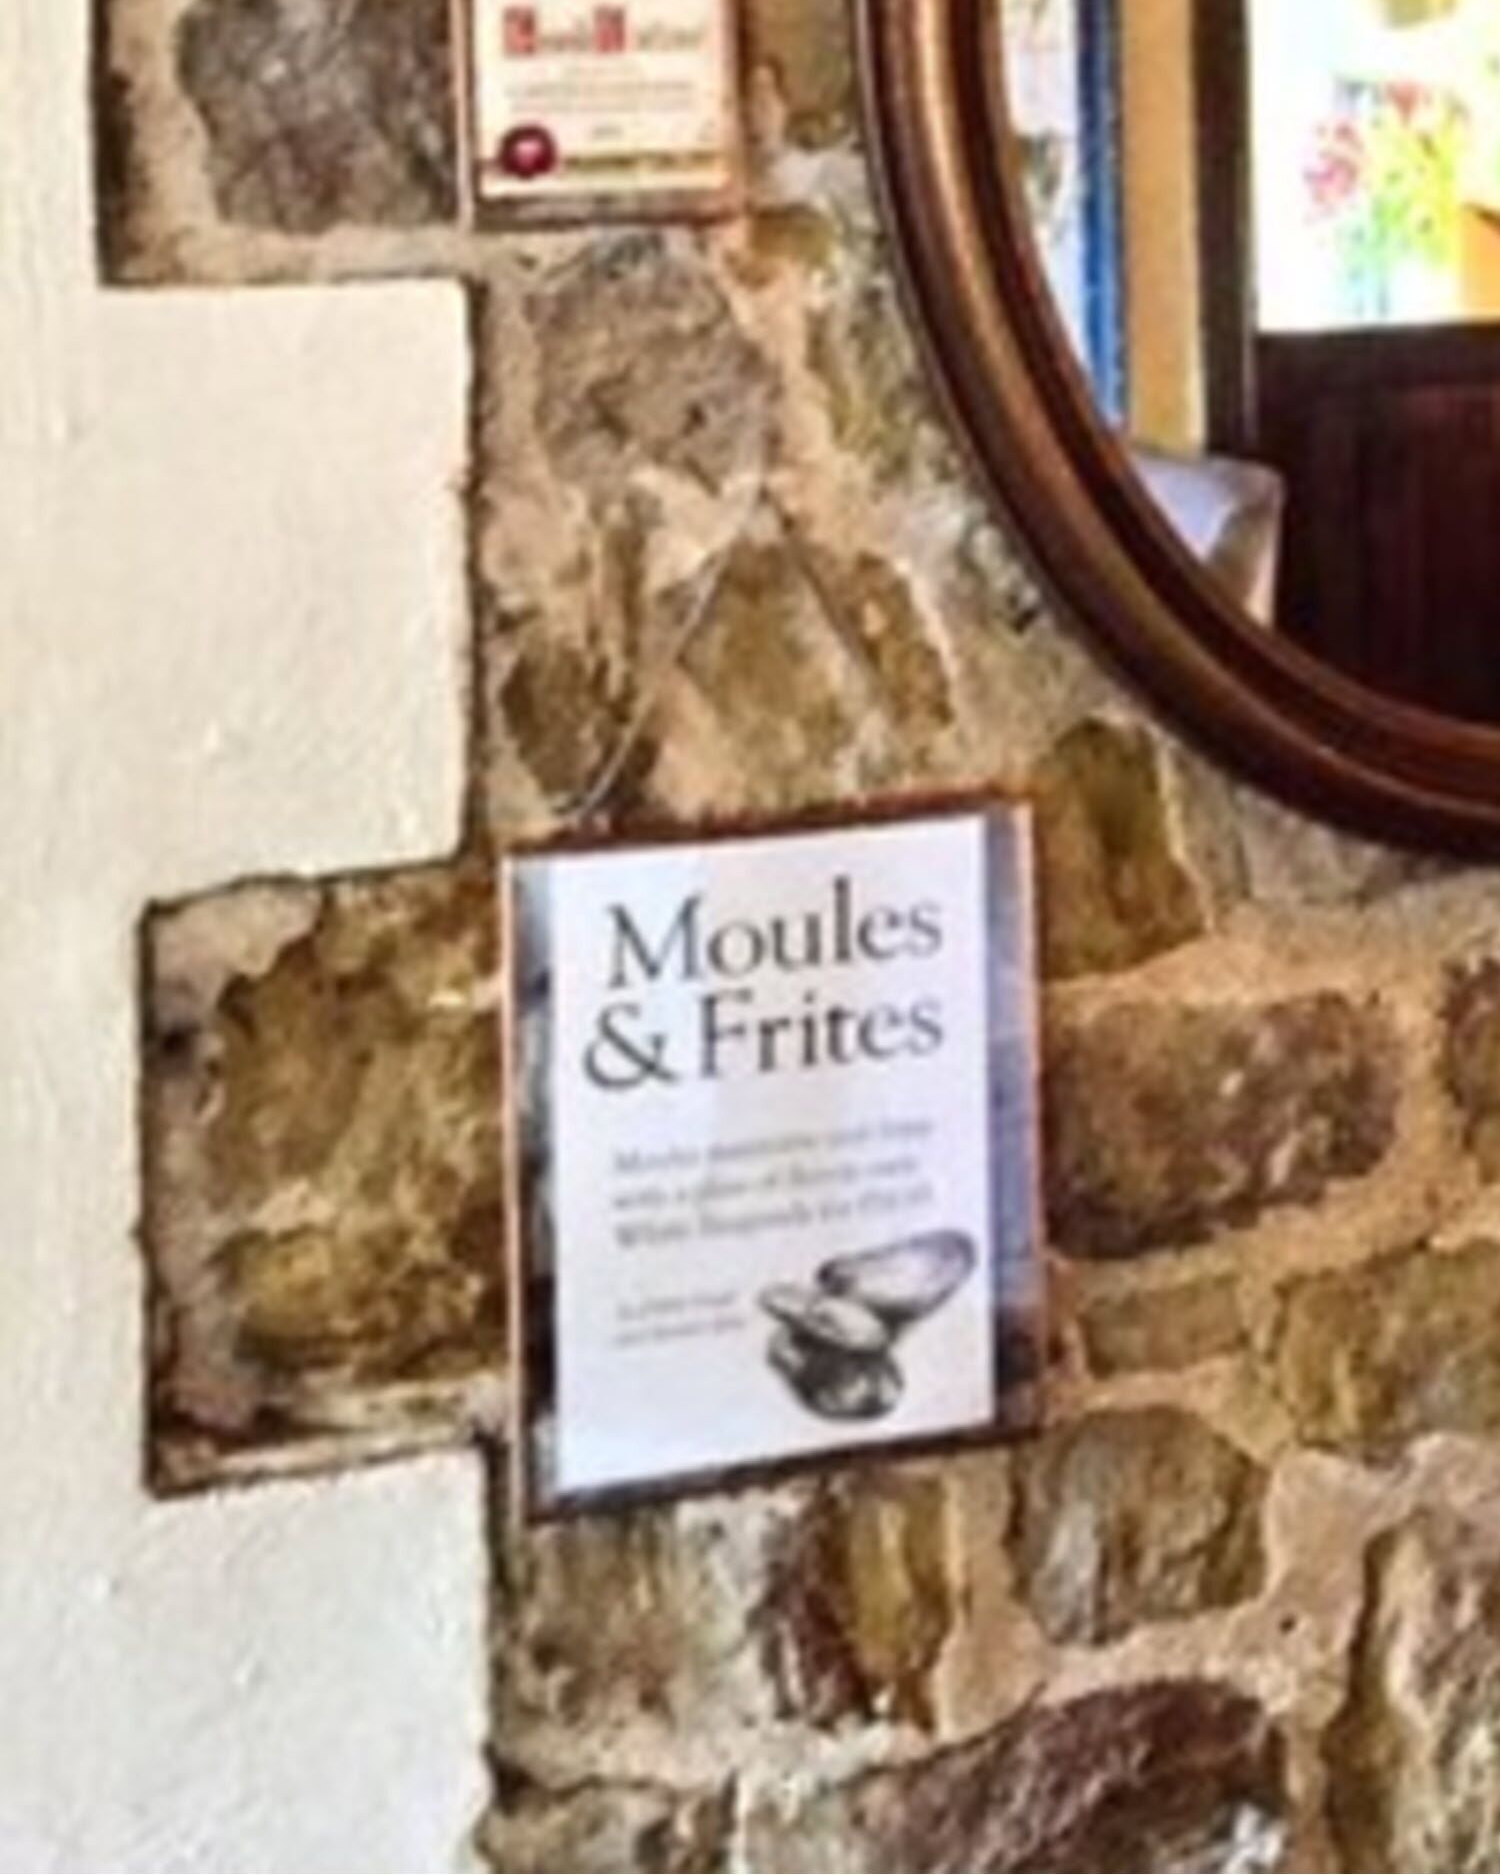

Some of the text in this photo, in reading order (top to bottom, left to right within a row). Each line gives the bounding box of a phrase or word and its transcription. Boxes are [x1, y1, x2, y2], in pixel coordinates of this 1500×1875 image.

[607, 875, 942, 989] Moules
[582, 988, 943, 1091] & Frites
